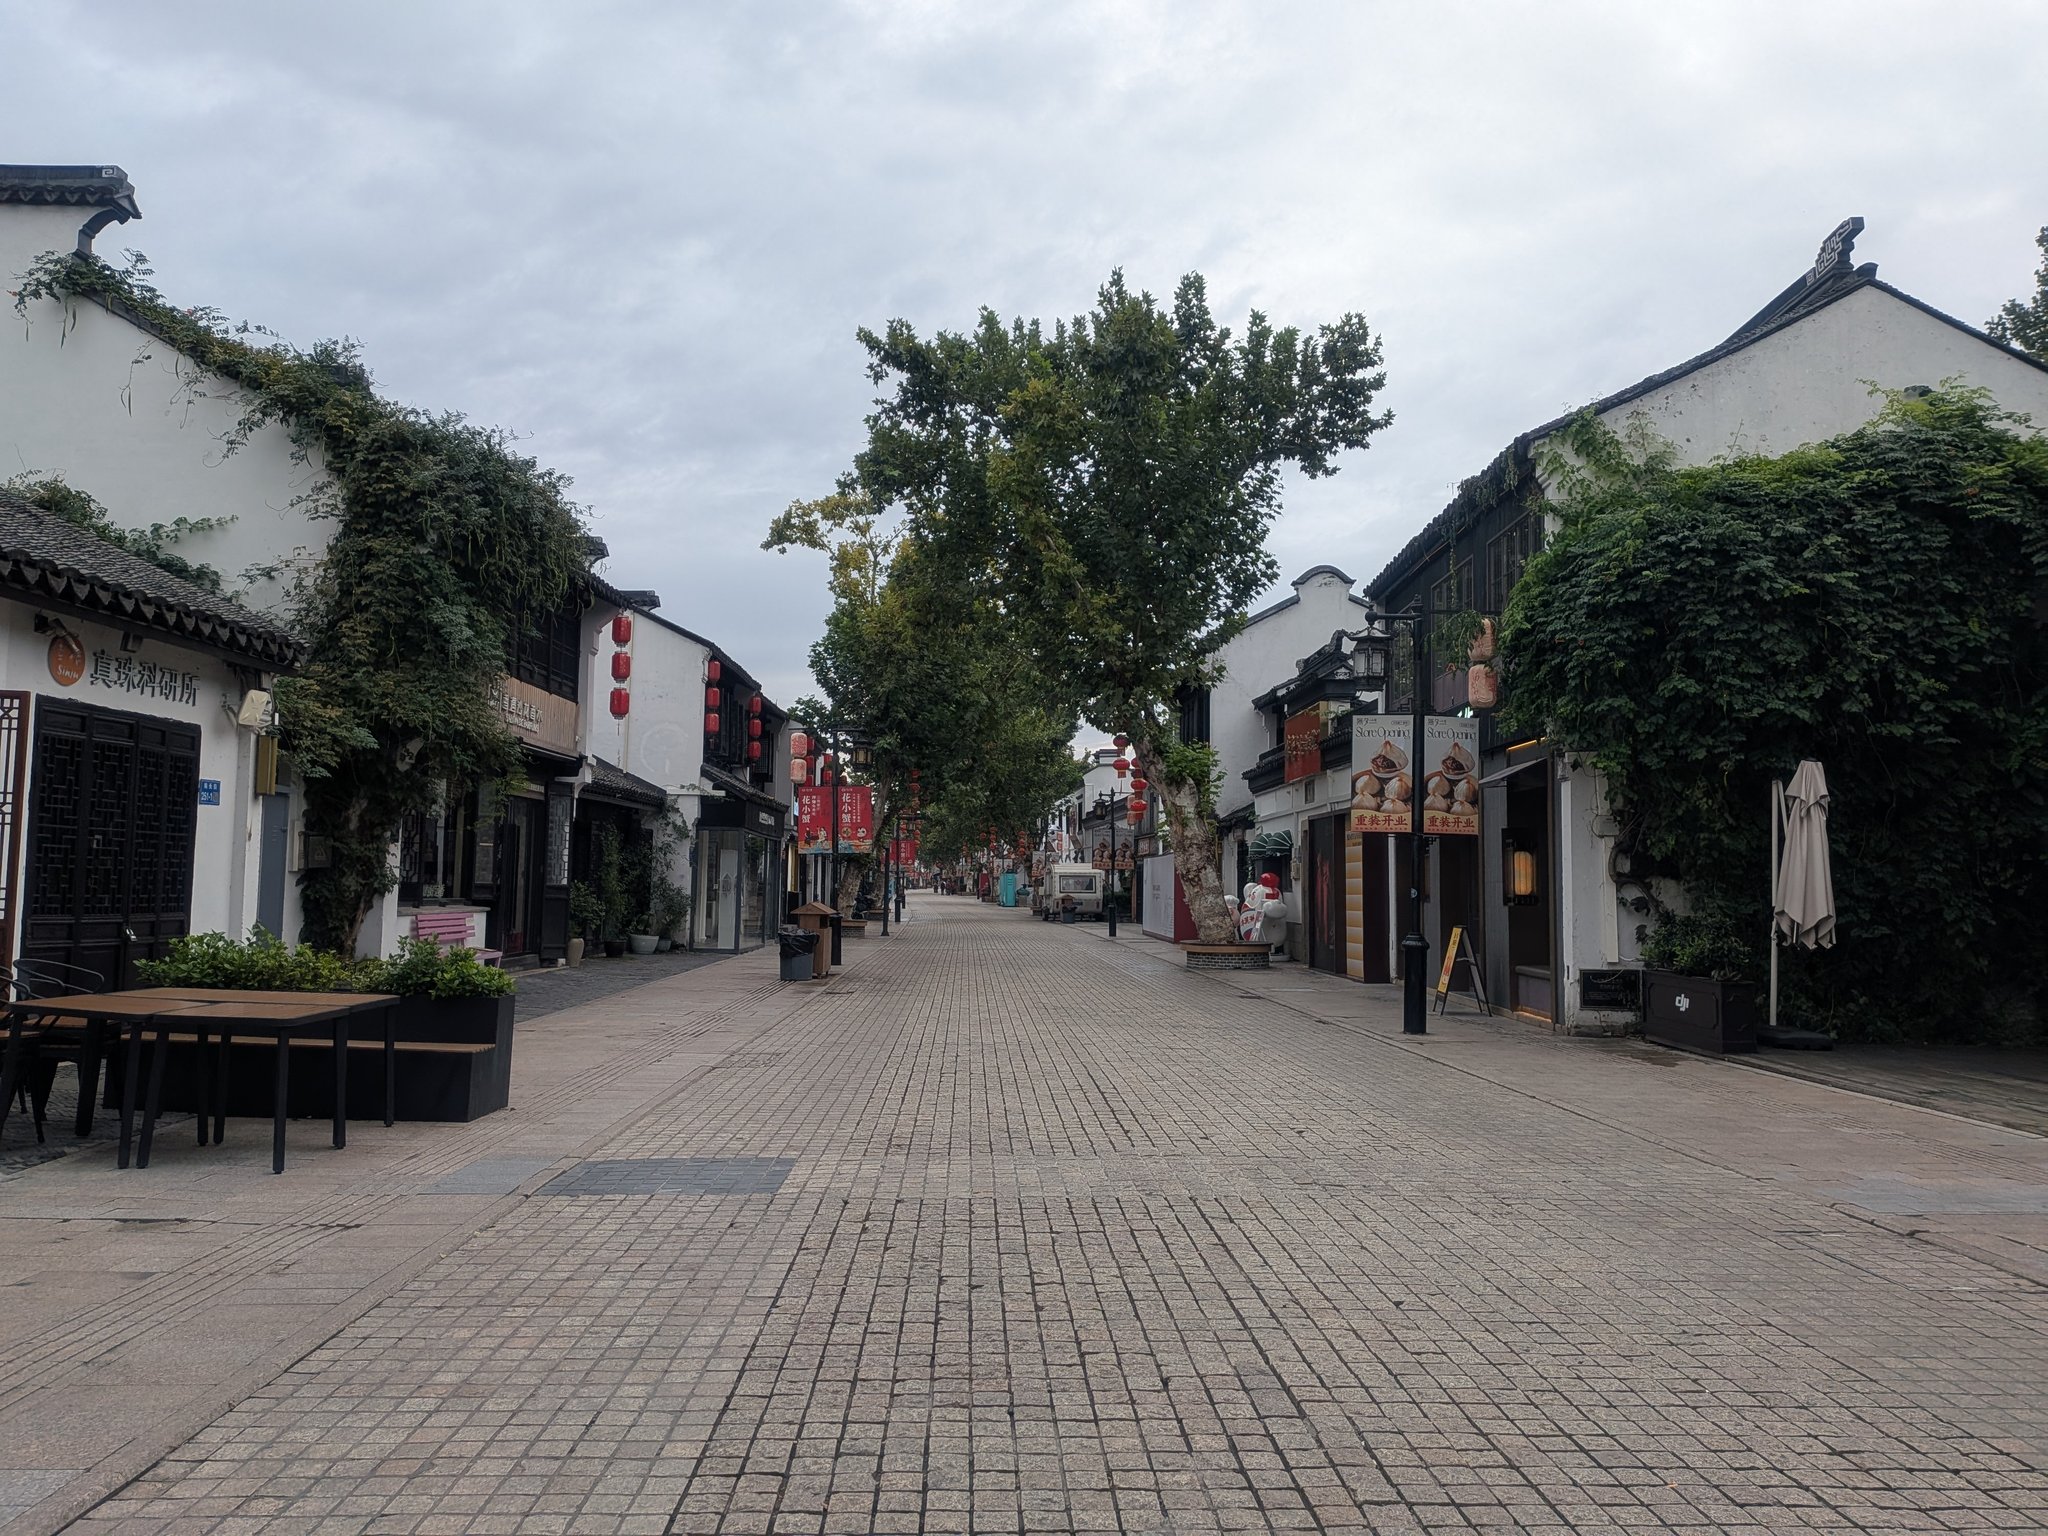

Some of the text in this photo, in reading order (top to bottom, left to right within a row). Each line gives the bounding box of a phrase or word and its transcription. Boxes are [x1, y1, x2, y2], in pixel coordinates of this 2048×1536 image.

[90, 648, 200, 706] 真珠科研所
[1355, 726, 1410, 740] Store Opening
[1426, 727, 1477, 742] Store Opening
[801, 795, 811, 823] 花小蟹
[841, 793, 852, 823] 花小蟹
[1355, 814, 1408, 827] 重装开业
[1427, 815, 1475, 829] 重装开业
[1675, 993, 1690, 1012] dji
